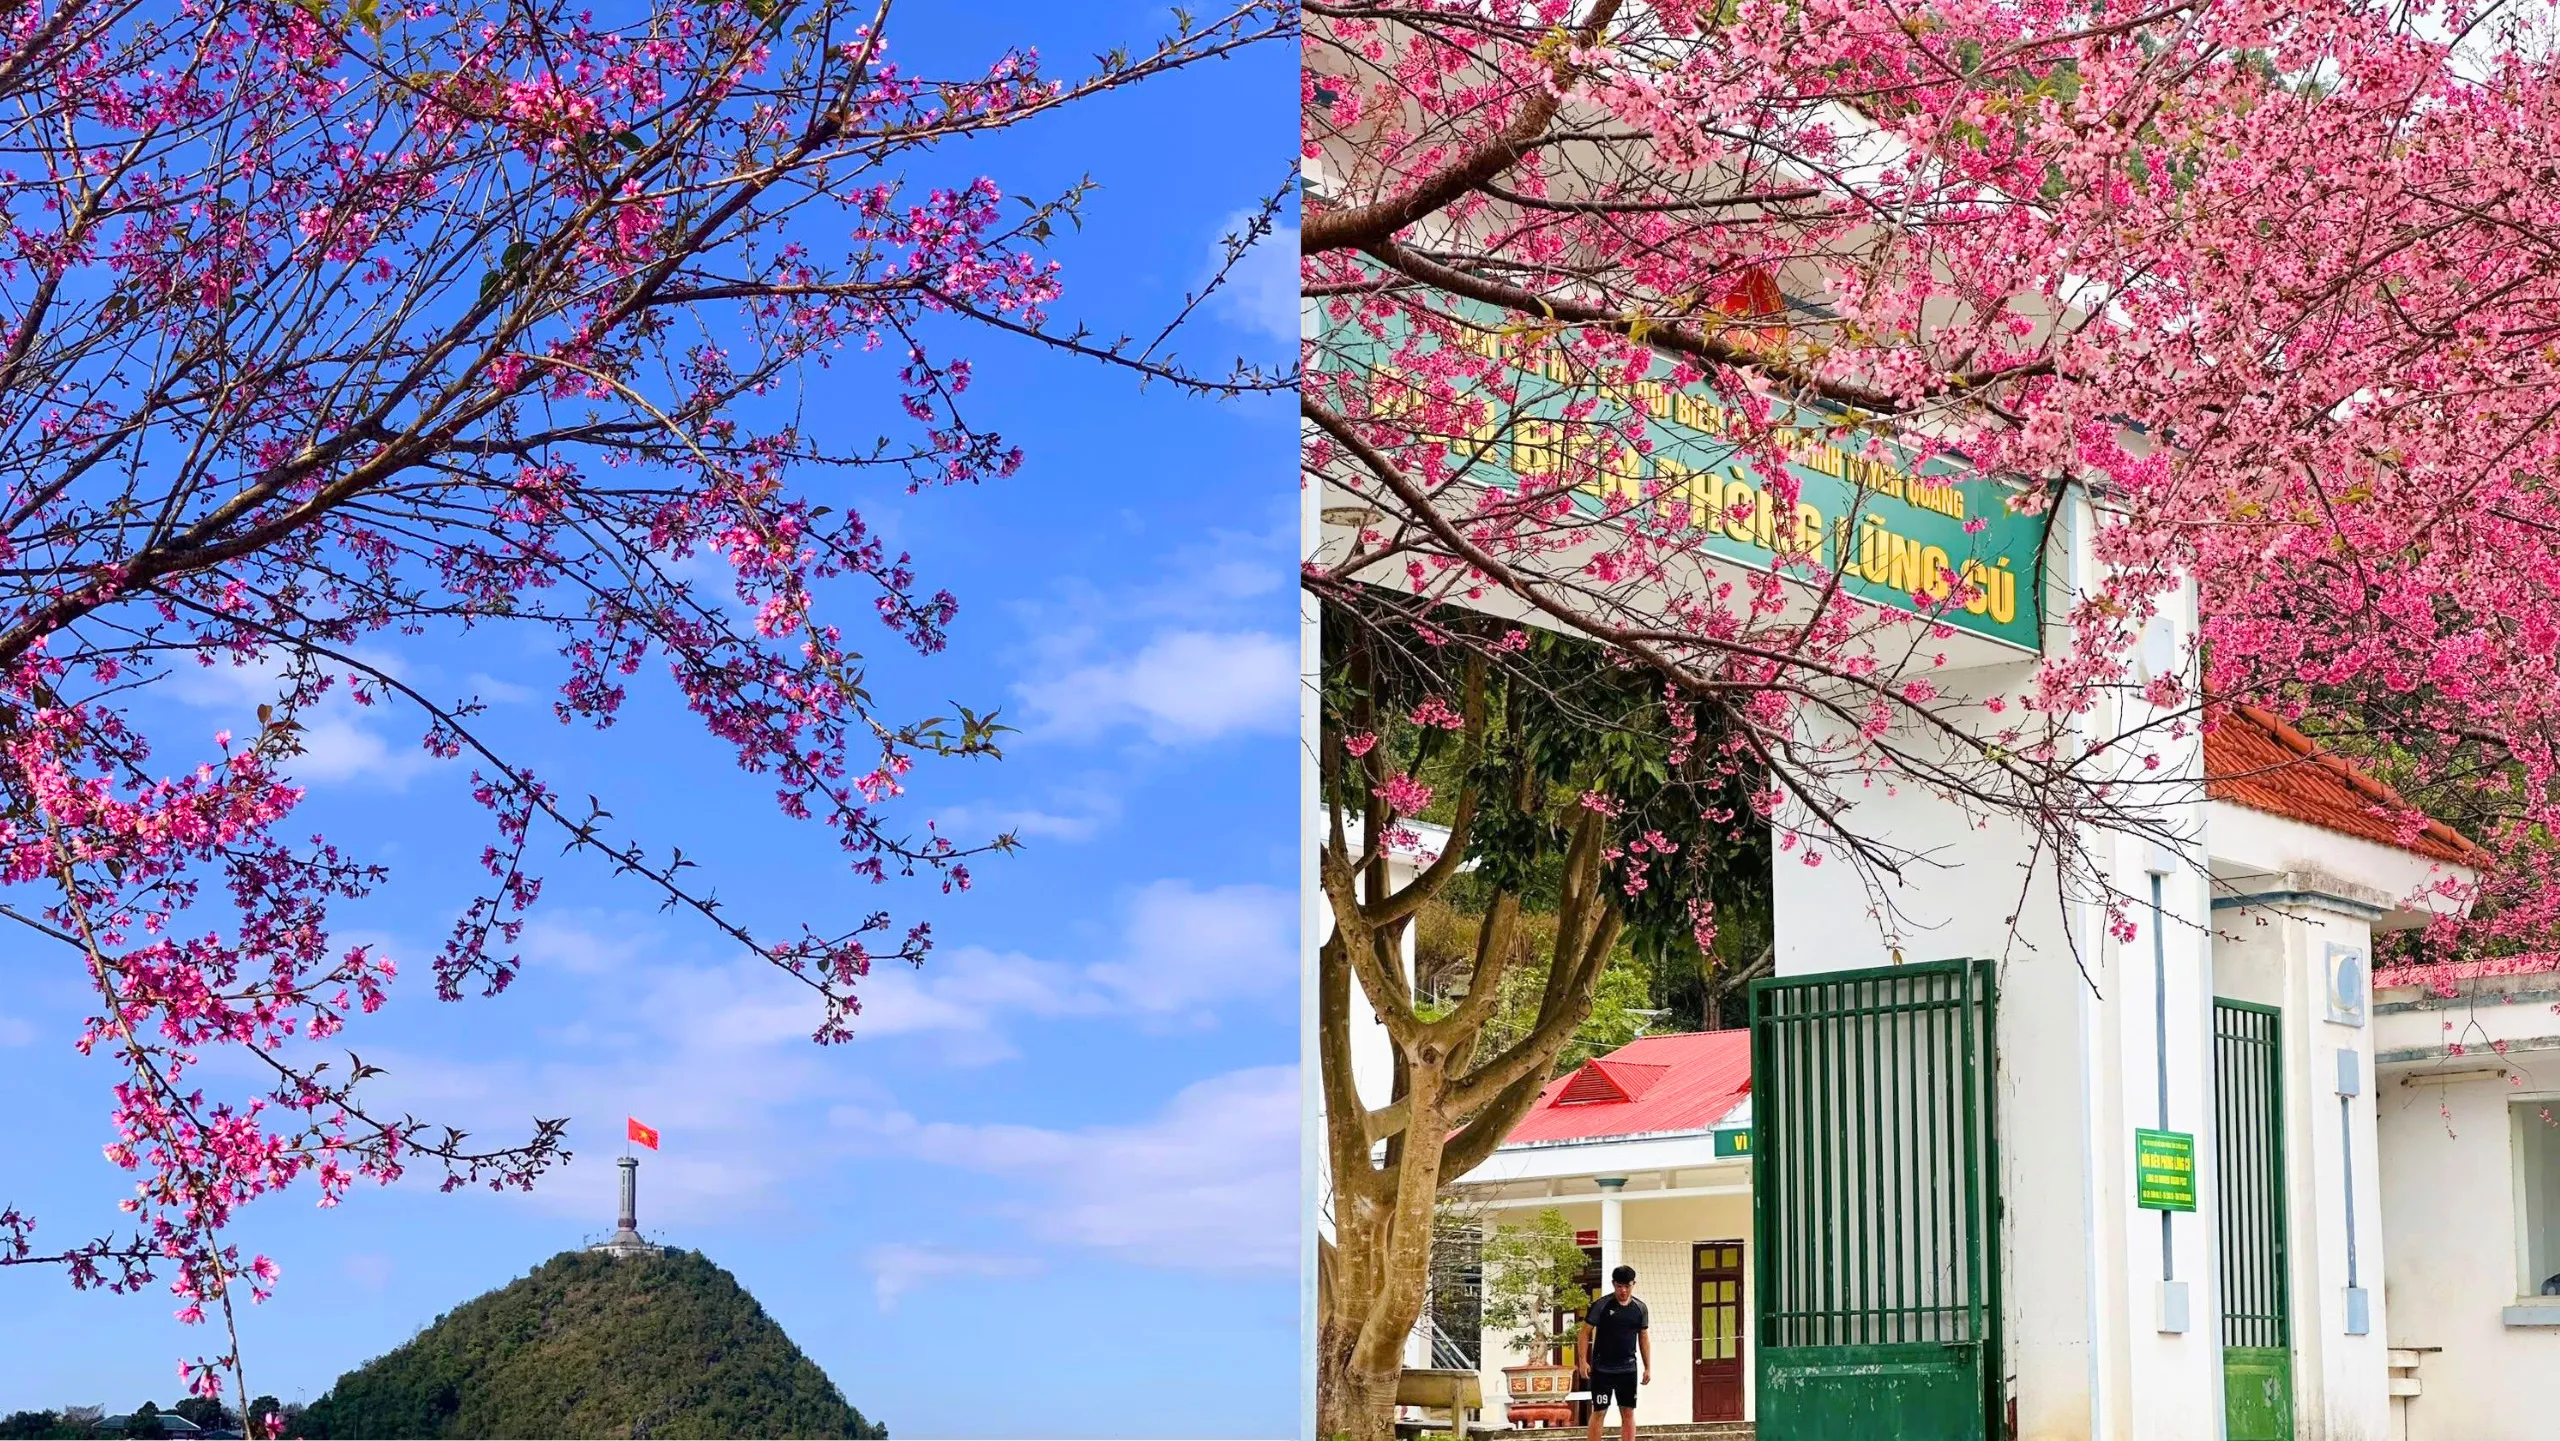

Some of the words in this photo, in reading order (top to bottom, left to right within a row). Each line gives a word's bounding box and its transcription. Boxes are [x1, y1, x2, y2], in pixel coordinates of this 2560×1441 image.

[1905, 476, 1964, 520] QUANG
[1834, 513, 1949, 600] LŨNG
[1596, 1394, 1608, 1404] 09
